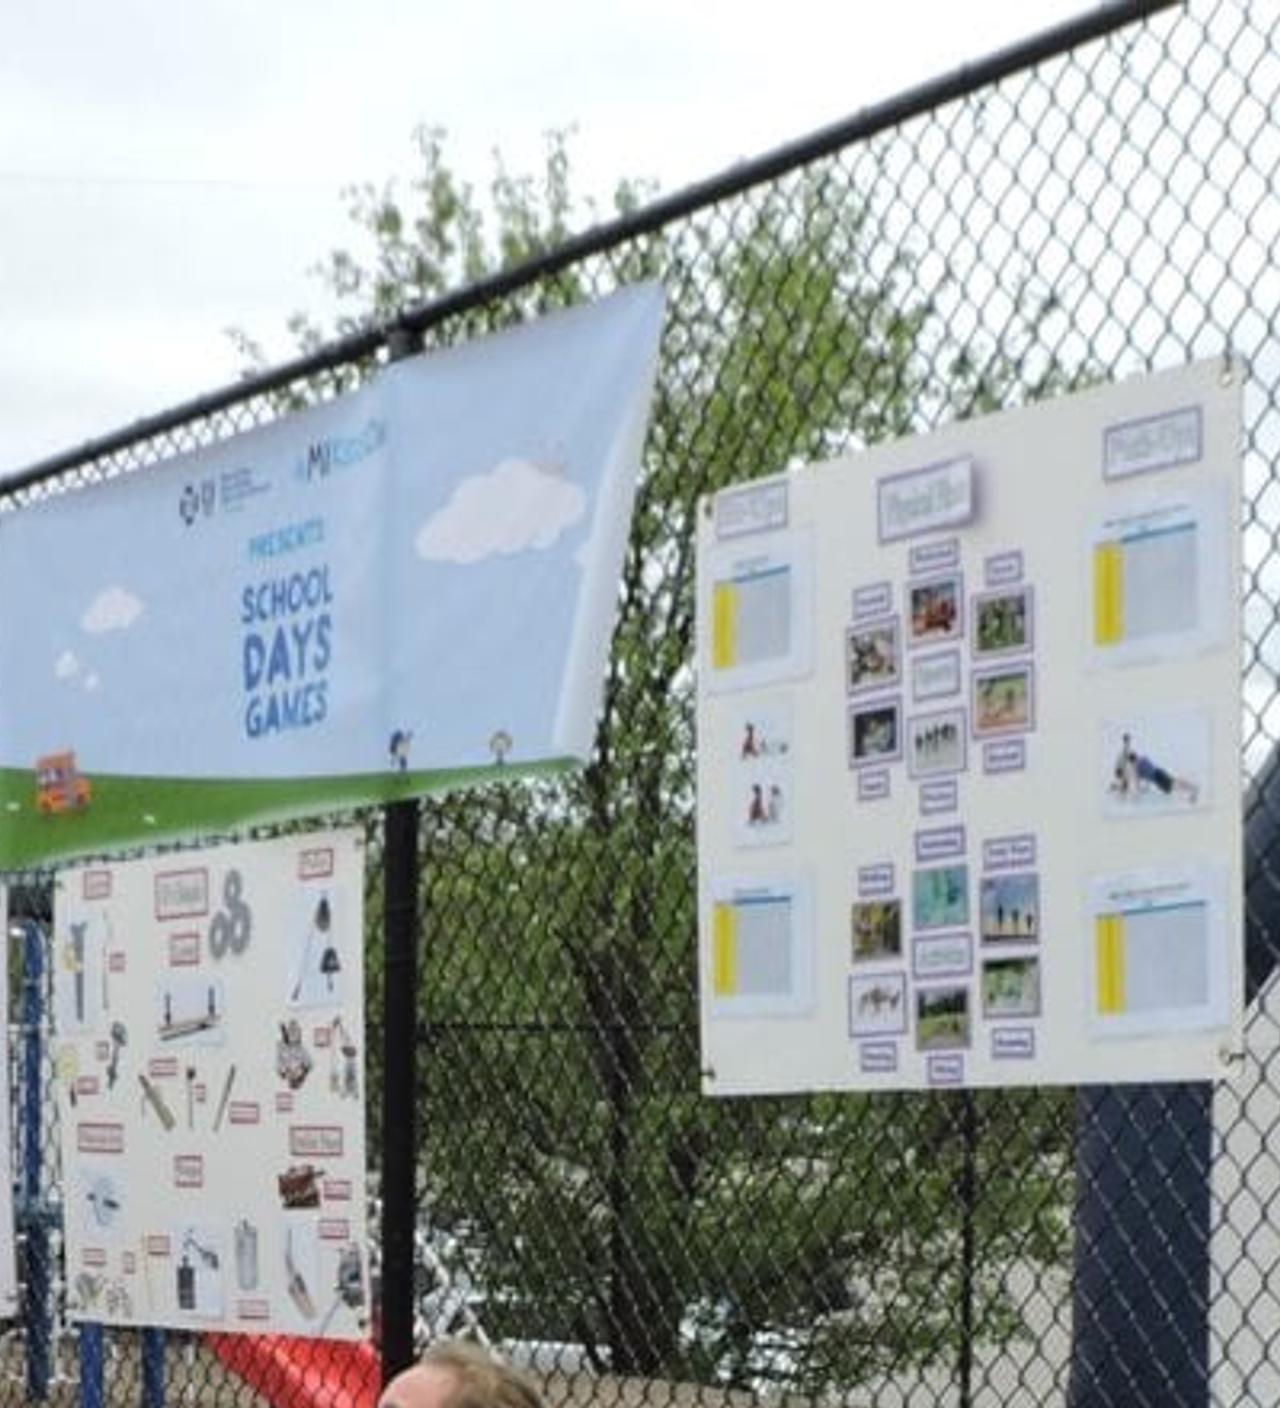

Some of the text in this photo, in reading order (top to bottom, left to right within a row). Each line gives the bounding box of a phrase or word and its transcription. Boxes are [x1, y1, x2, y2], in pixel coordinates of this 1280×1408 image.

[241, 564, 333, 624] SCHOOL
[243, 614, 332, 692] DAYS
[245, 680, 328, 738] GAMES
